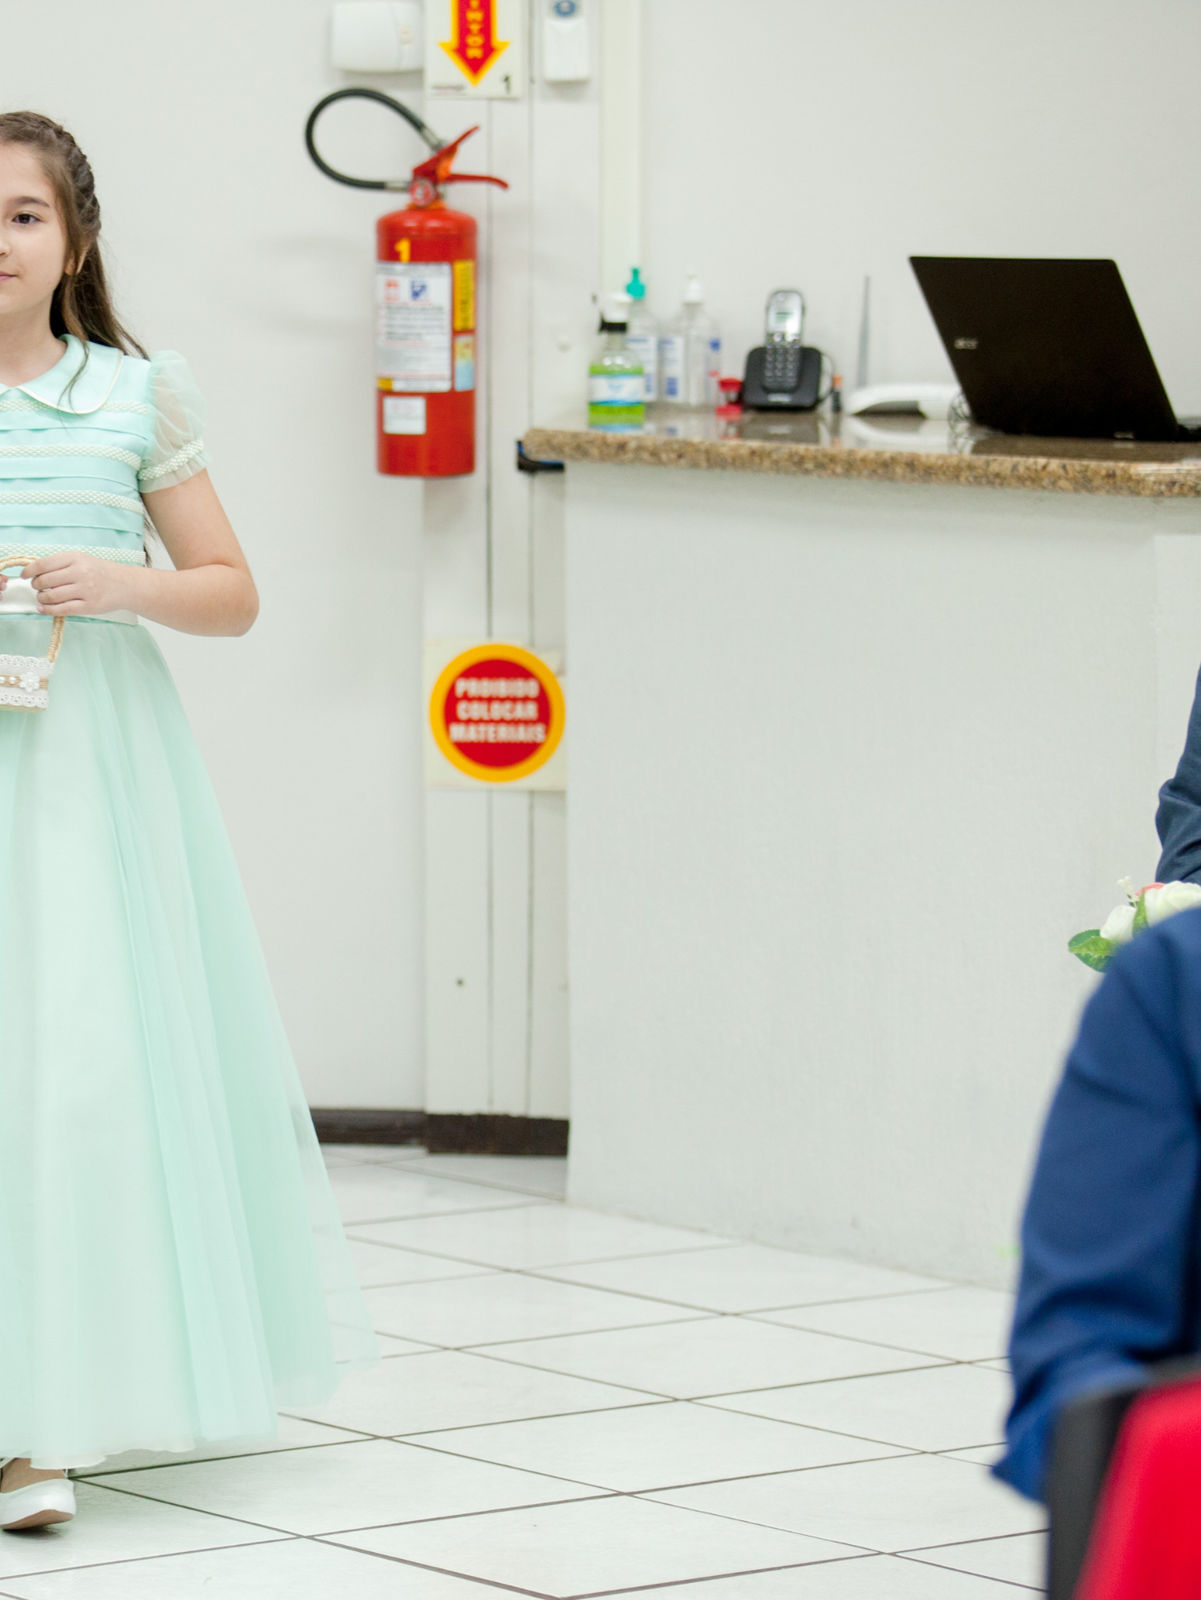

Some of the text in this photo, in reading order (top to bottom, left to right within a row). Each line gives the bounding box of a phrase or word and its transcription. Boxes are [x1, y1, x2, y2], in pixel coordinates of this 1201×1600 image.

[394, 238, 410, 263] 1
[457, 700, 538, 720] COLOCAR
[449, 722, 546, 743] MATERIAIS
